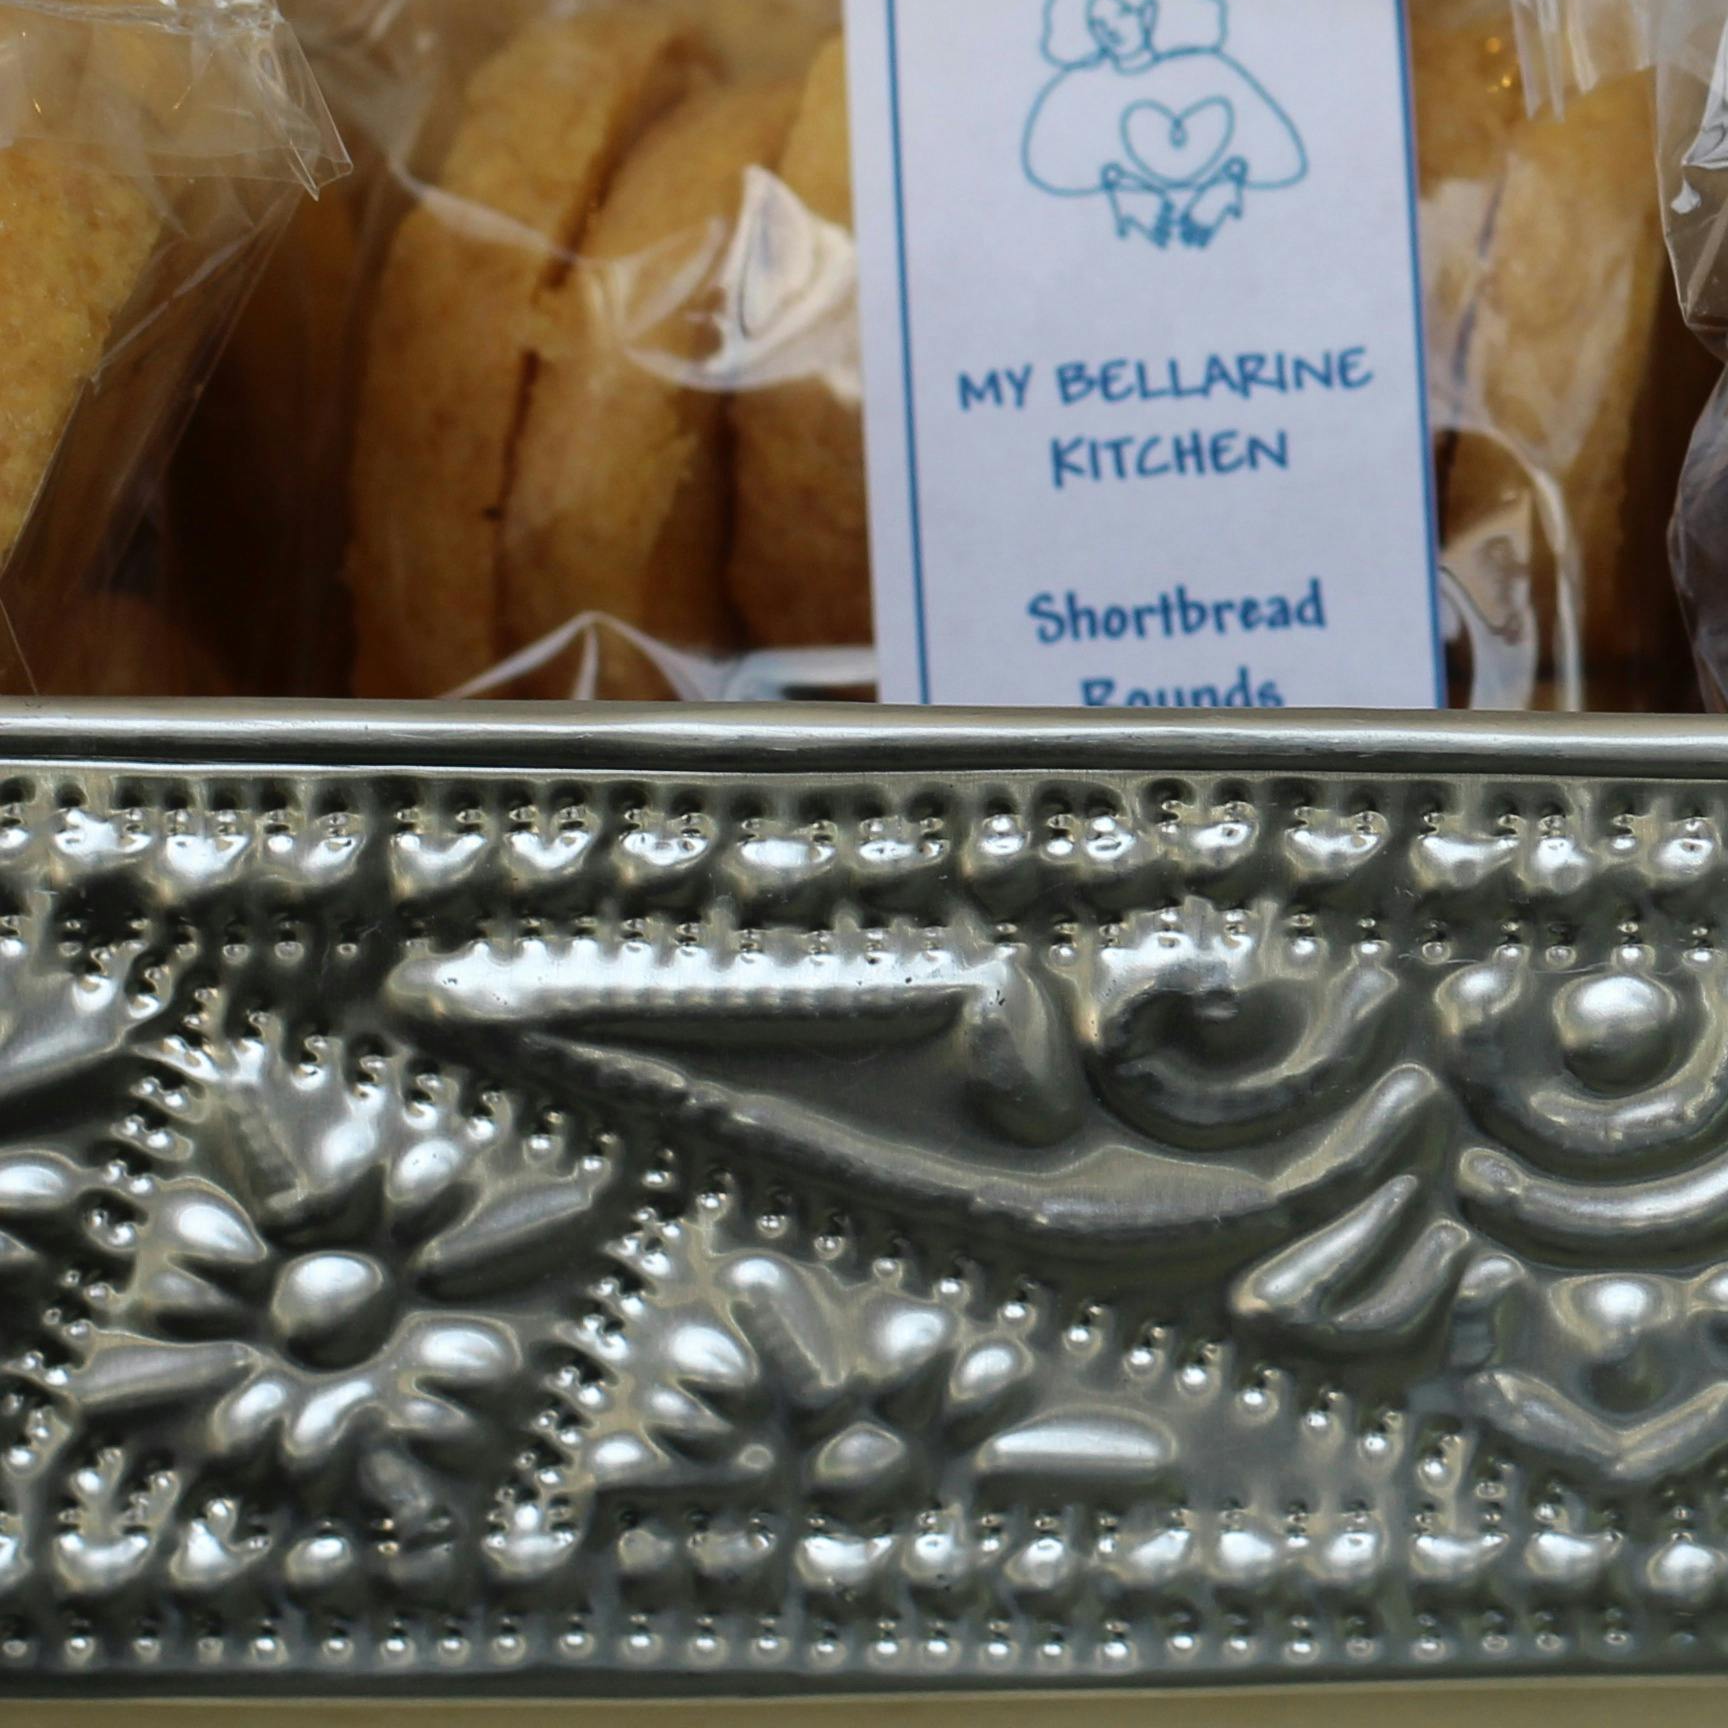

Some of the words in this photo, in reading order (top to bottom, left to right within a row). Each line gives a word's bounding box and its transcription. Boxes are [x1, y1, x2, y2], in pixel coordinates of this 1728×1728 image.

[958, 365, 1032, 411] MY
[1056, 347, 1372, 405] BELLARINE
[1051, 431, 1288, 488] KITCHEN
[1027, 578, 1326, 644] Shortbread
